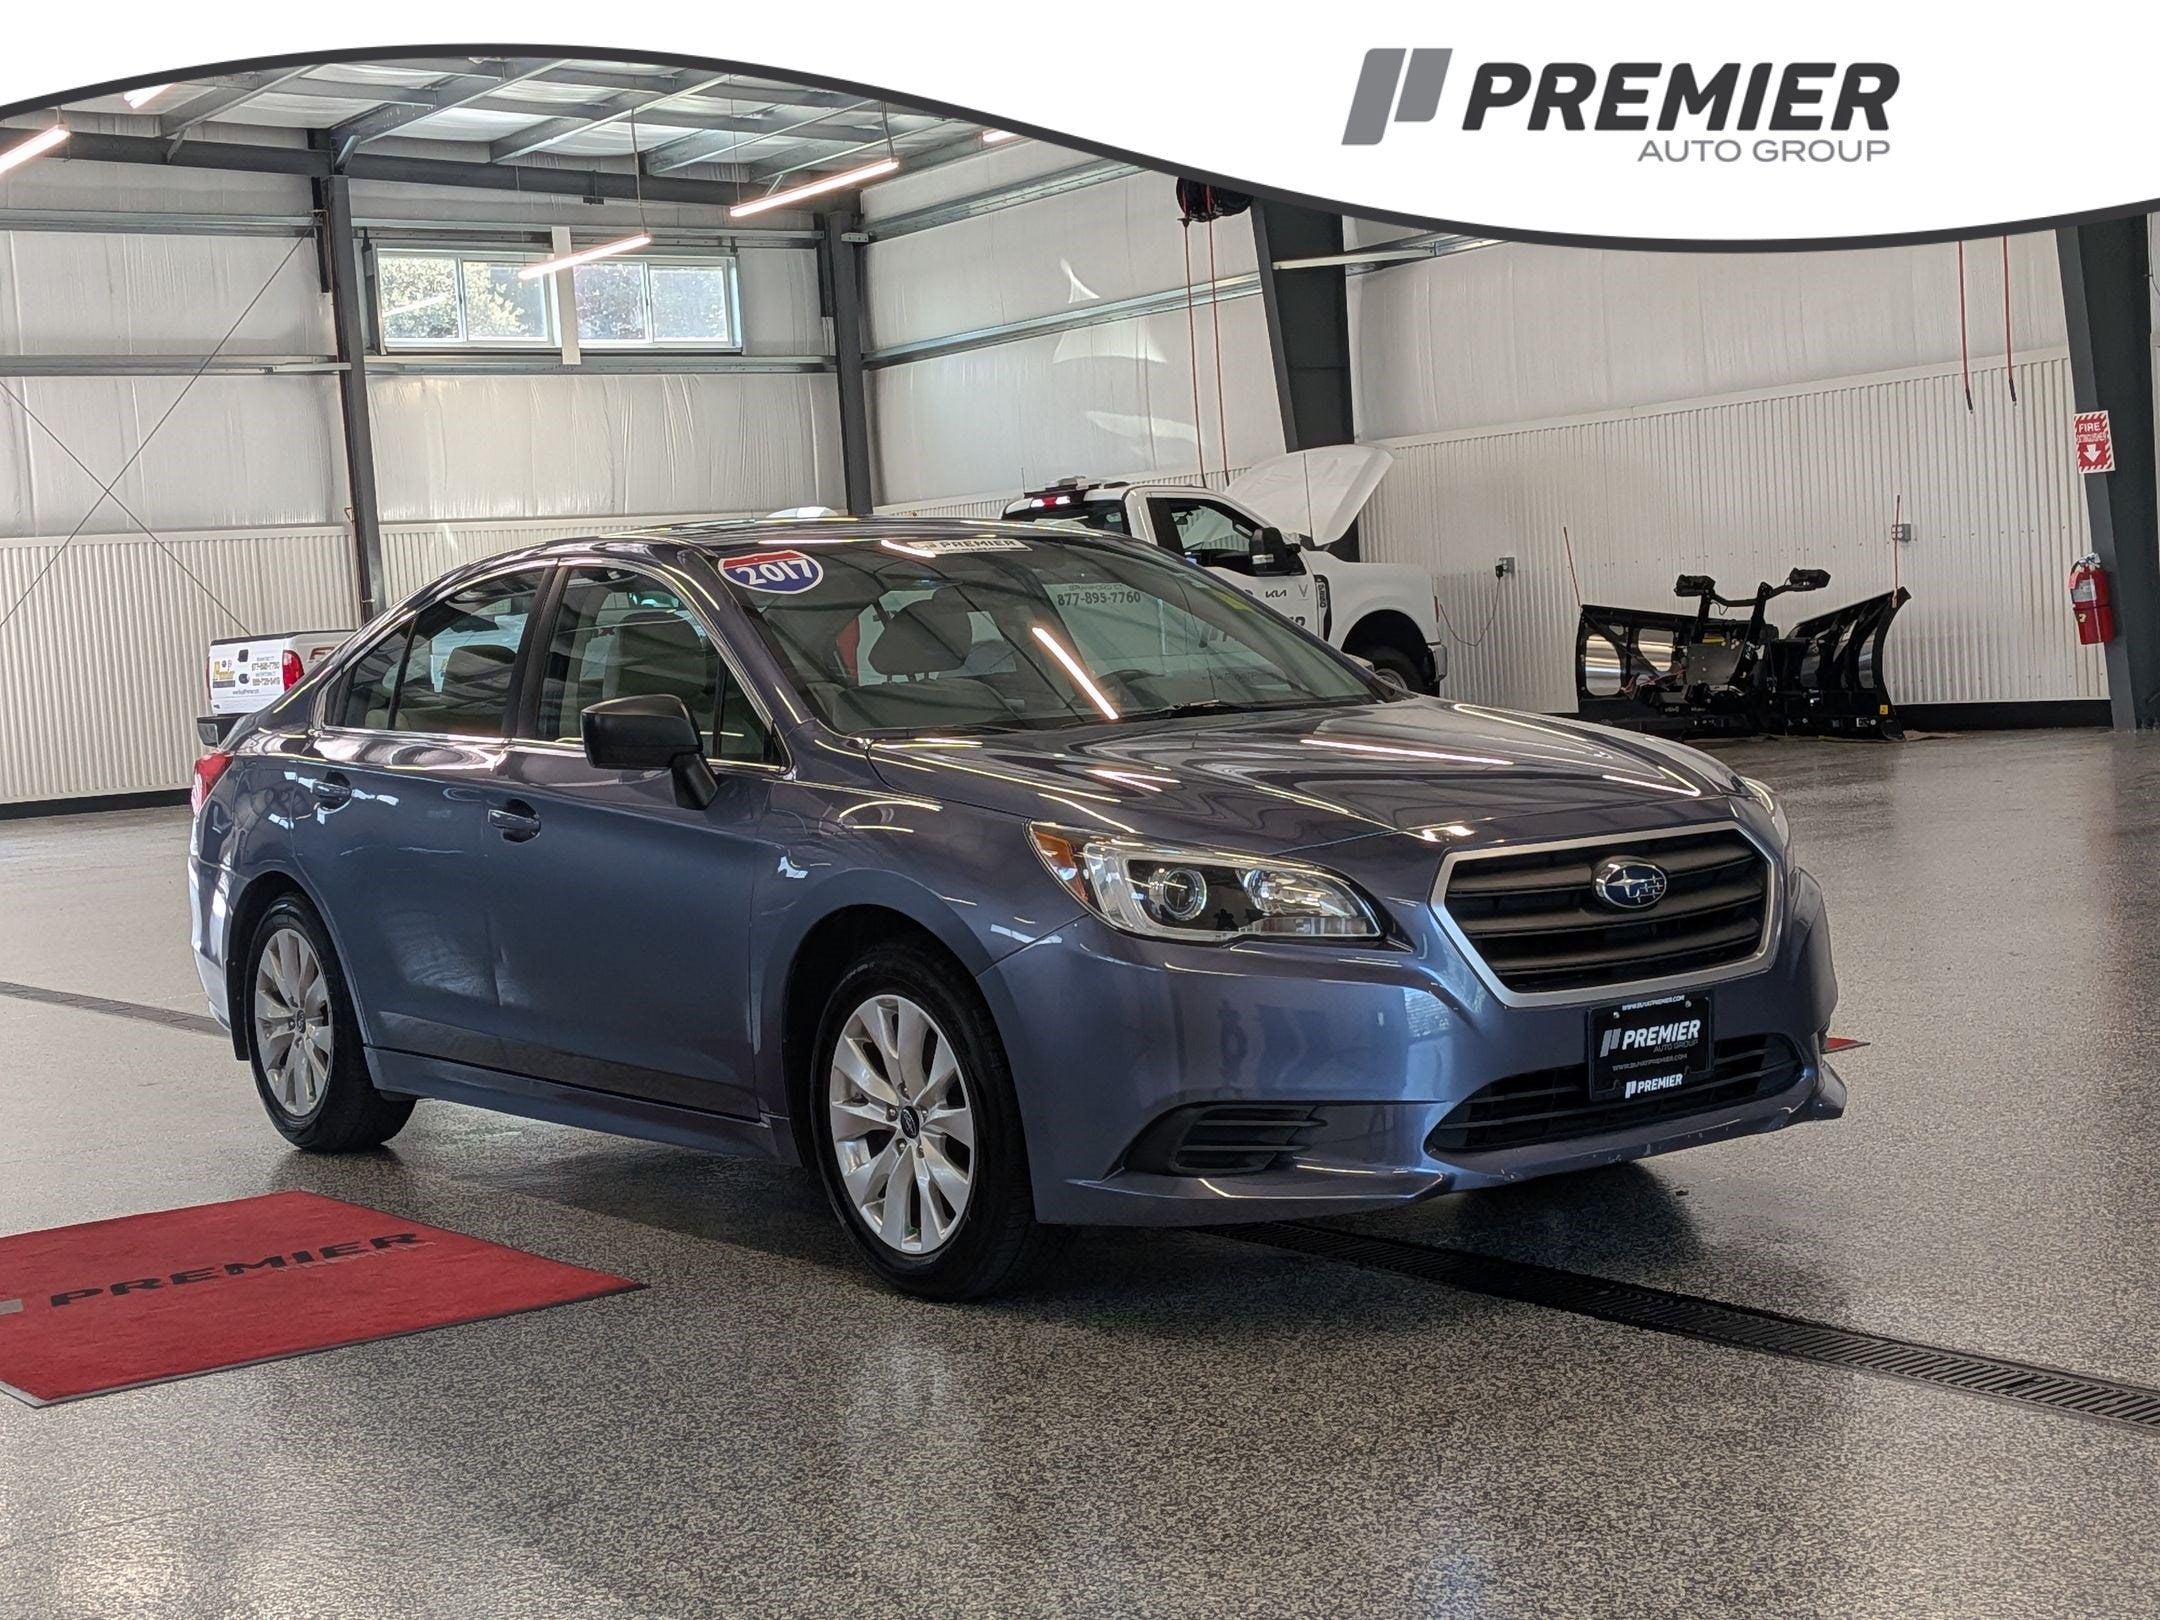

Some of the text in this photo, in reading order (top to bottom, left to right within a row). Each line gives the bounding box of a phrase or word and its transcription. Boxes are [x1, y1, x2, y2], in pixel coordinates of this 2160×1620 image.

[2078, 421, 2102, 433] FIRE
[939, 538, 1017, 549] PREMIER
[735, 558, 815, 587] 2017
[1056, 591, 1142, 607] 877-895-7760
[1621, 1019, 1702, 1051] PREMIER
[1652, 1039, 1699, 1053] AUTO GROUP
[1636, 1073, 1684, 1094] PREMIER
[50, 1232, 418, 1307] PREMIER
